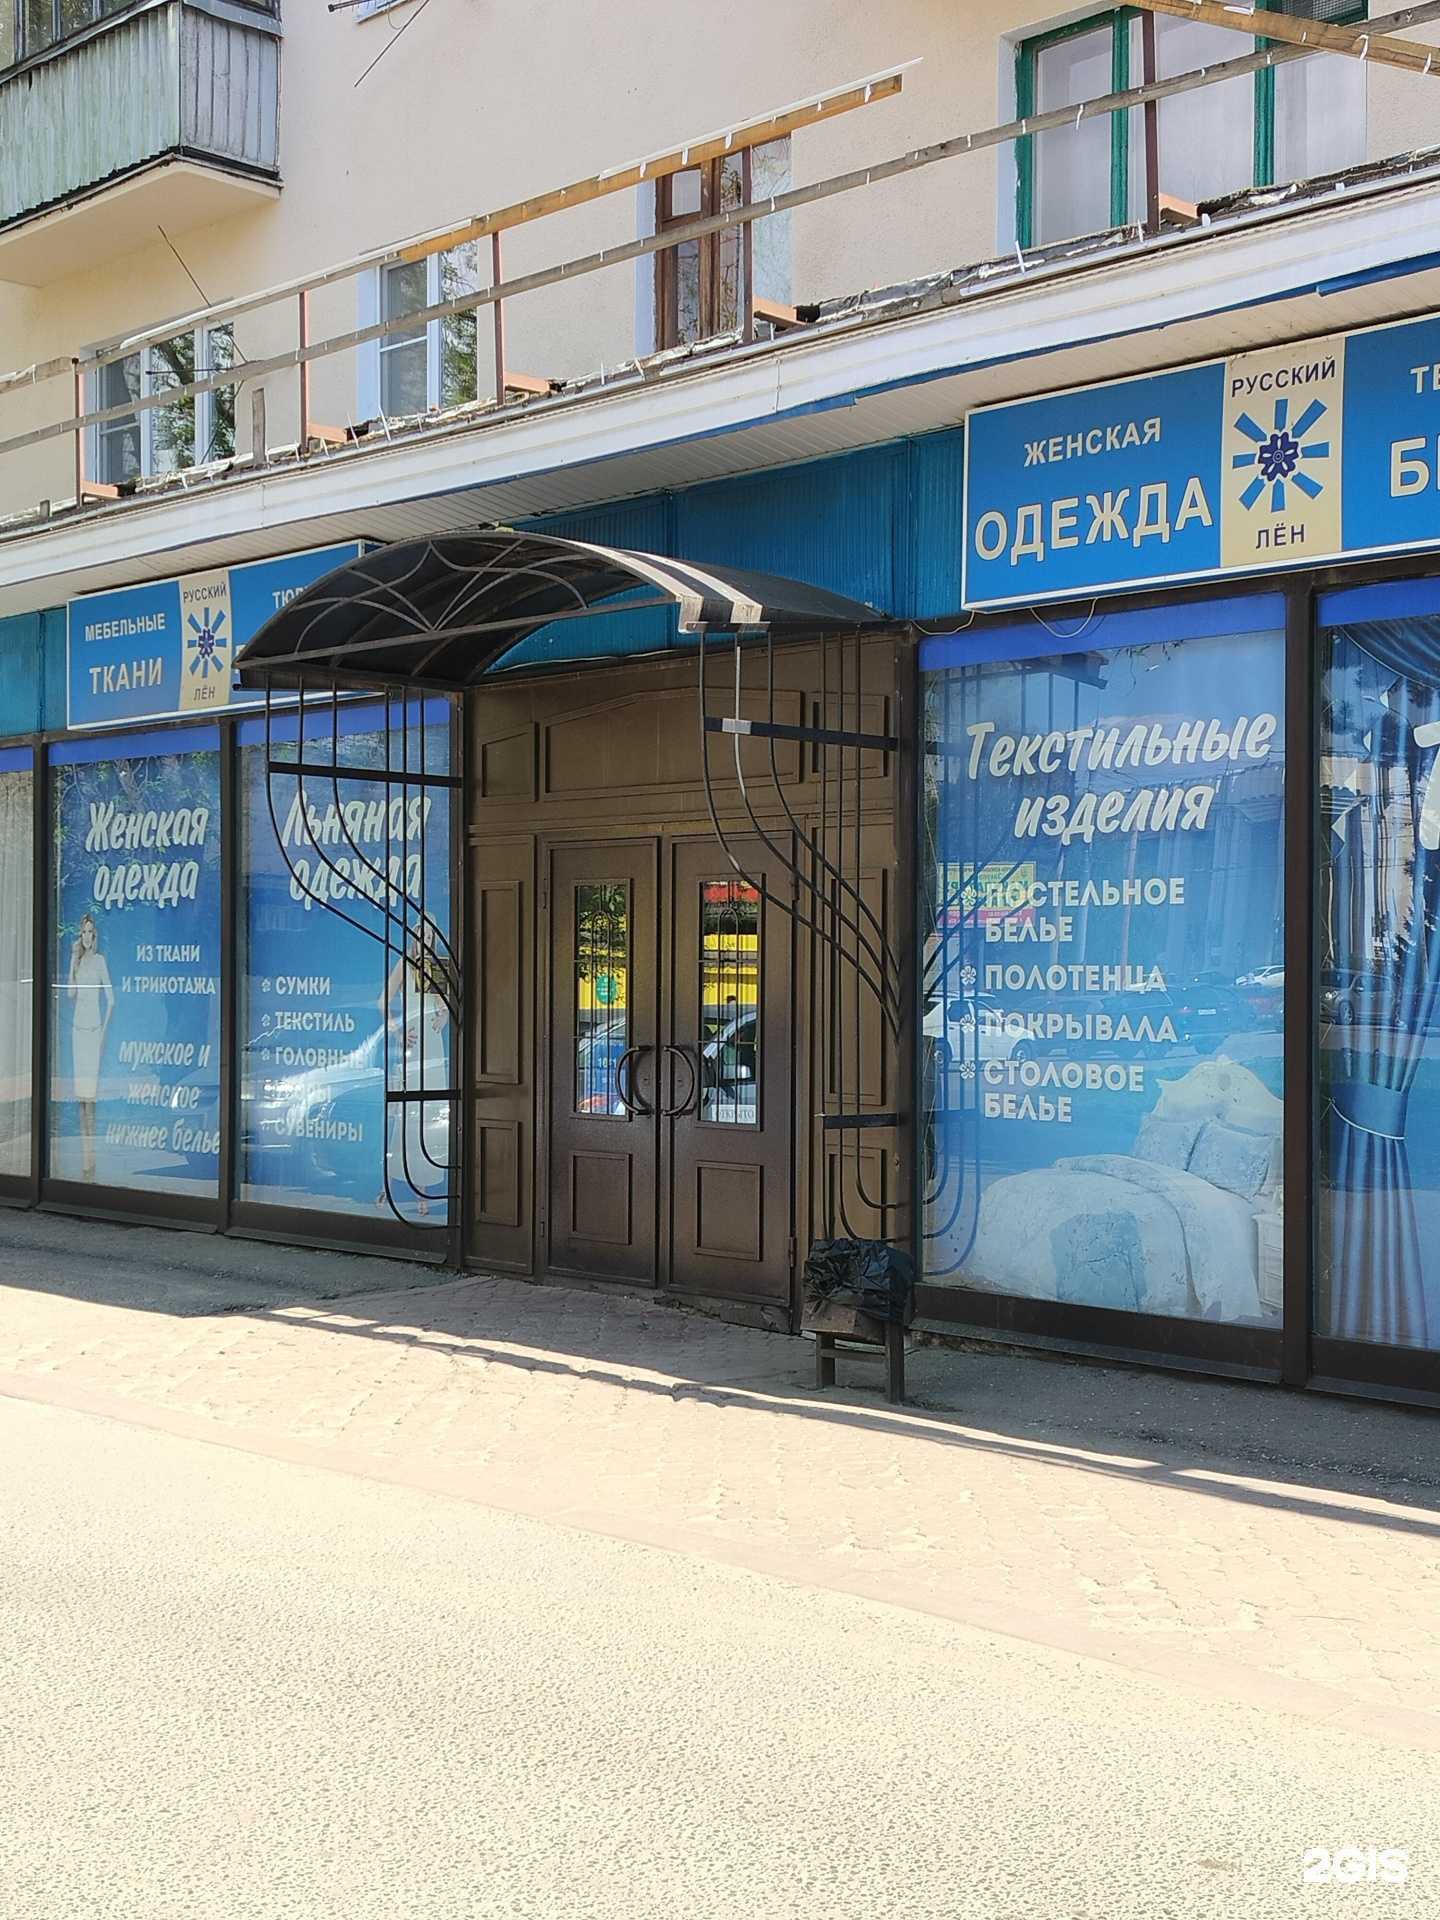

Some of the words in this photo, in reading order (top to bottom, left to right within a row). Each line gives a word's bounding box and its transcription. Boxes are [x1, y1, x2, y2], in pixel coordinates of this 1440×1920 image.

[1231, 356, 1337, 397] РУССКИЙ
[1023, 416, 1162, 467] ЖЕНСКАЯ
[1389, 435, 1440, 498] Б
[974, 476, 1213, 566] ОДЕЖДА
[1255, 522, 1306, 549] ЛЁН
[182, 583, 228, 603] РУССКИЙ
[84, 612, 166, 642] МЕБЕЛЬНЫЕ
[89, 656, 163, 695] ТКАНИ
[193, 685, 216, 701] ЛЁН
[966, 712, 1278, 780] Текстильные
[85, 800, 209, 853] Женская
[281, 790, 432, 848] Льняная
[1014, 783, 1217, 846] изделия
[93, 858, 200, 910] одежда
[290, 854, 423, 911] одежда
[985, 876, 1186, 908] ПОСТЕЛЬНОЕ
[985, 915, 1074, 943] БЕЛЬЕ
[136, 944, 153, 962] ИЗ
[156, 944, 201, 962] ТКАНИ
[122, 976, 132, 993] И
[134, 976, 217, 995] ТРИКОТАЖА
[275, 976, 331, 996] СУМКИ
[985, 964, 1168, 996] ПОЛОТЕНЦА
[274, 1011, 356, 1033] ТЕКСТИЛЬ
[984, 1010, 1178, 1043] ПОКРЫВАЛА
[118, 1040, 195, 1071] мужское
[197, 1044, 212, 1068] и
[984, 1059, 1146, 1093] СТОЛОВОЕ
[126, 1083, 201, 1109] женское
[984, 1092, 1073, 1123] БЕЛЬЕ
[105, 1122, 168, 1149] нижнее
[172, 1118, 220, 1154] белье
[273, 1118, 364, 1143] СУВЕНИРЫ
